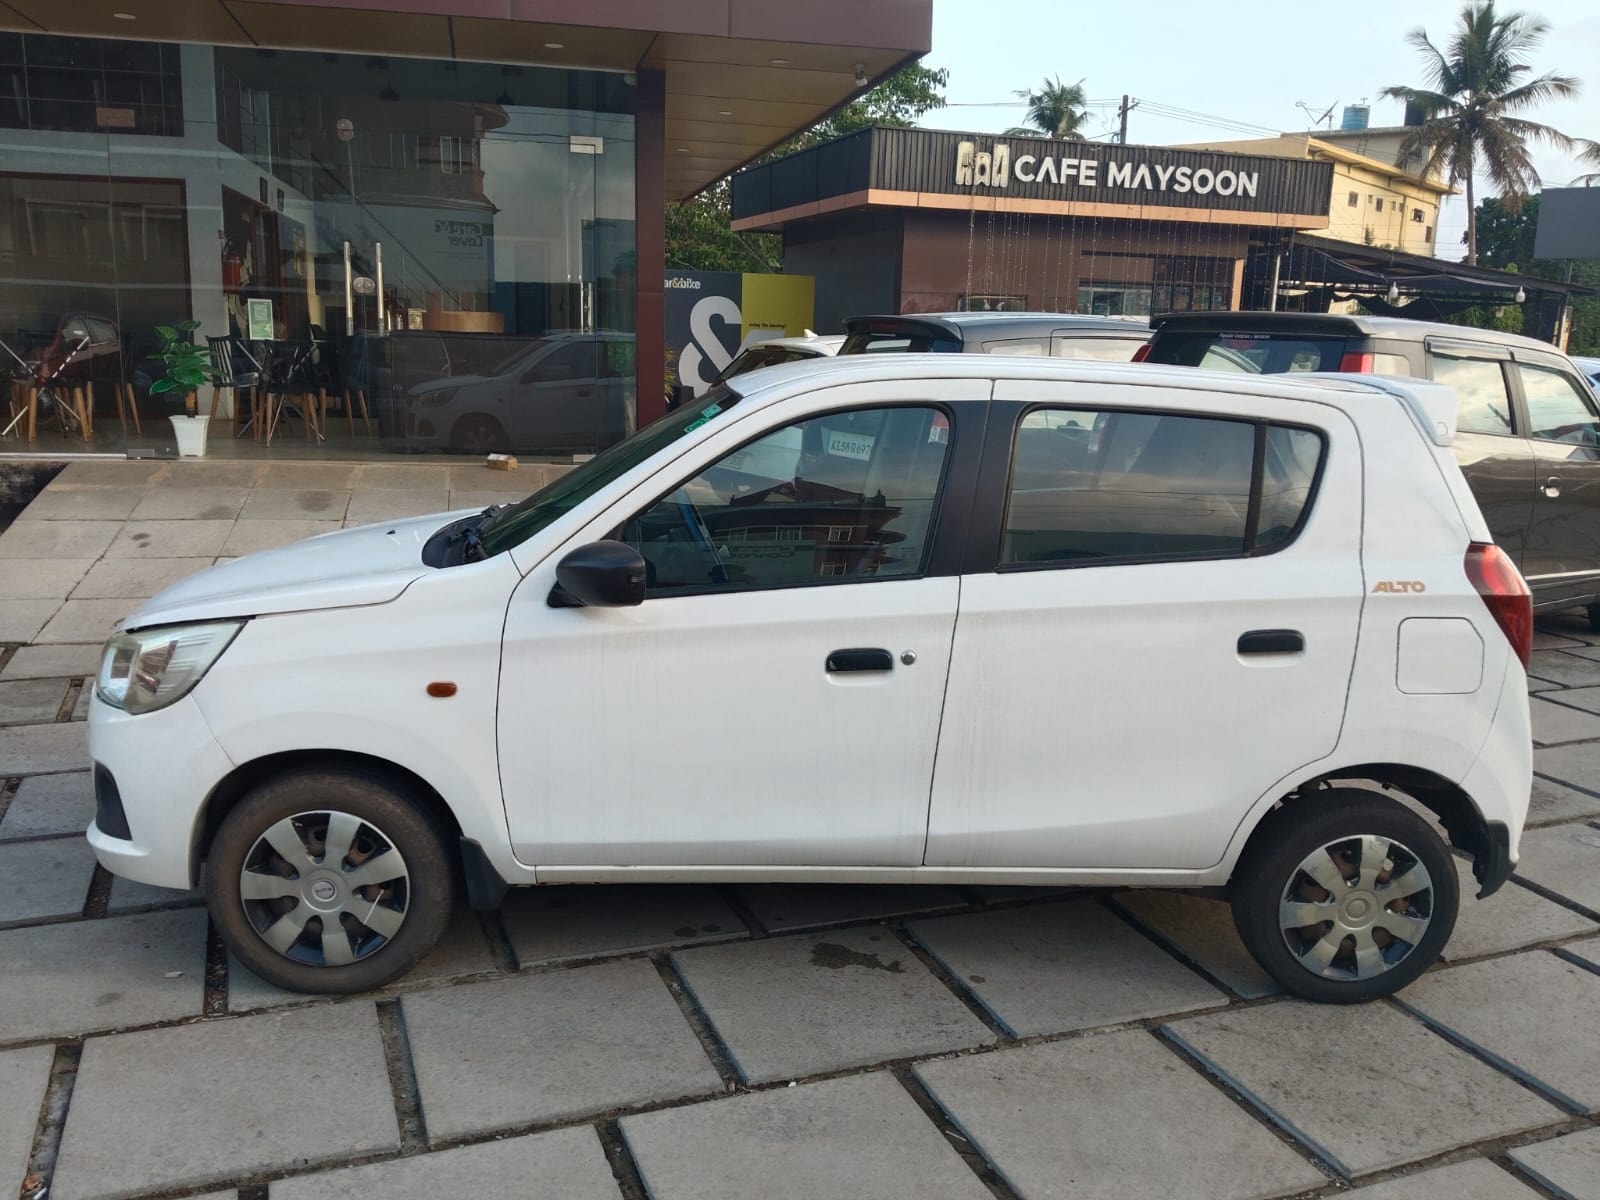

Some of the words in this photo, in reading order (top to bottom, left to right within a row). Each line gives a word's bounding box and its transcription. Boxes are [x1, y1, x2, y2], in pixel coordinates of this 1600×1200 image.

[1014, 155, 1098, 187] CAFE
[1107, 160, 1258, 197] MAYSOON
[664, 277, 701, 290] ar&bike
[1371, 580, 1426, 594] ALTO
